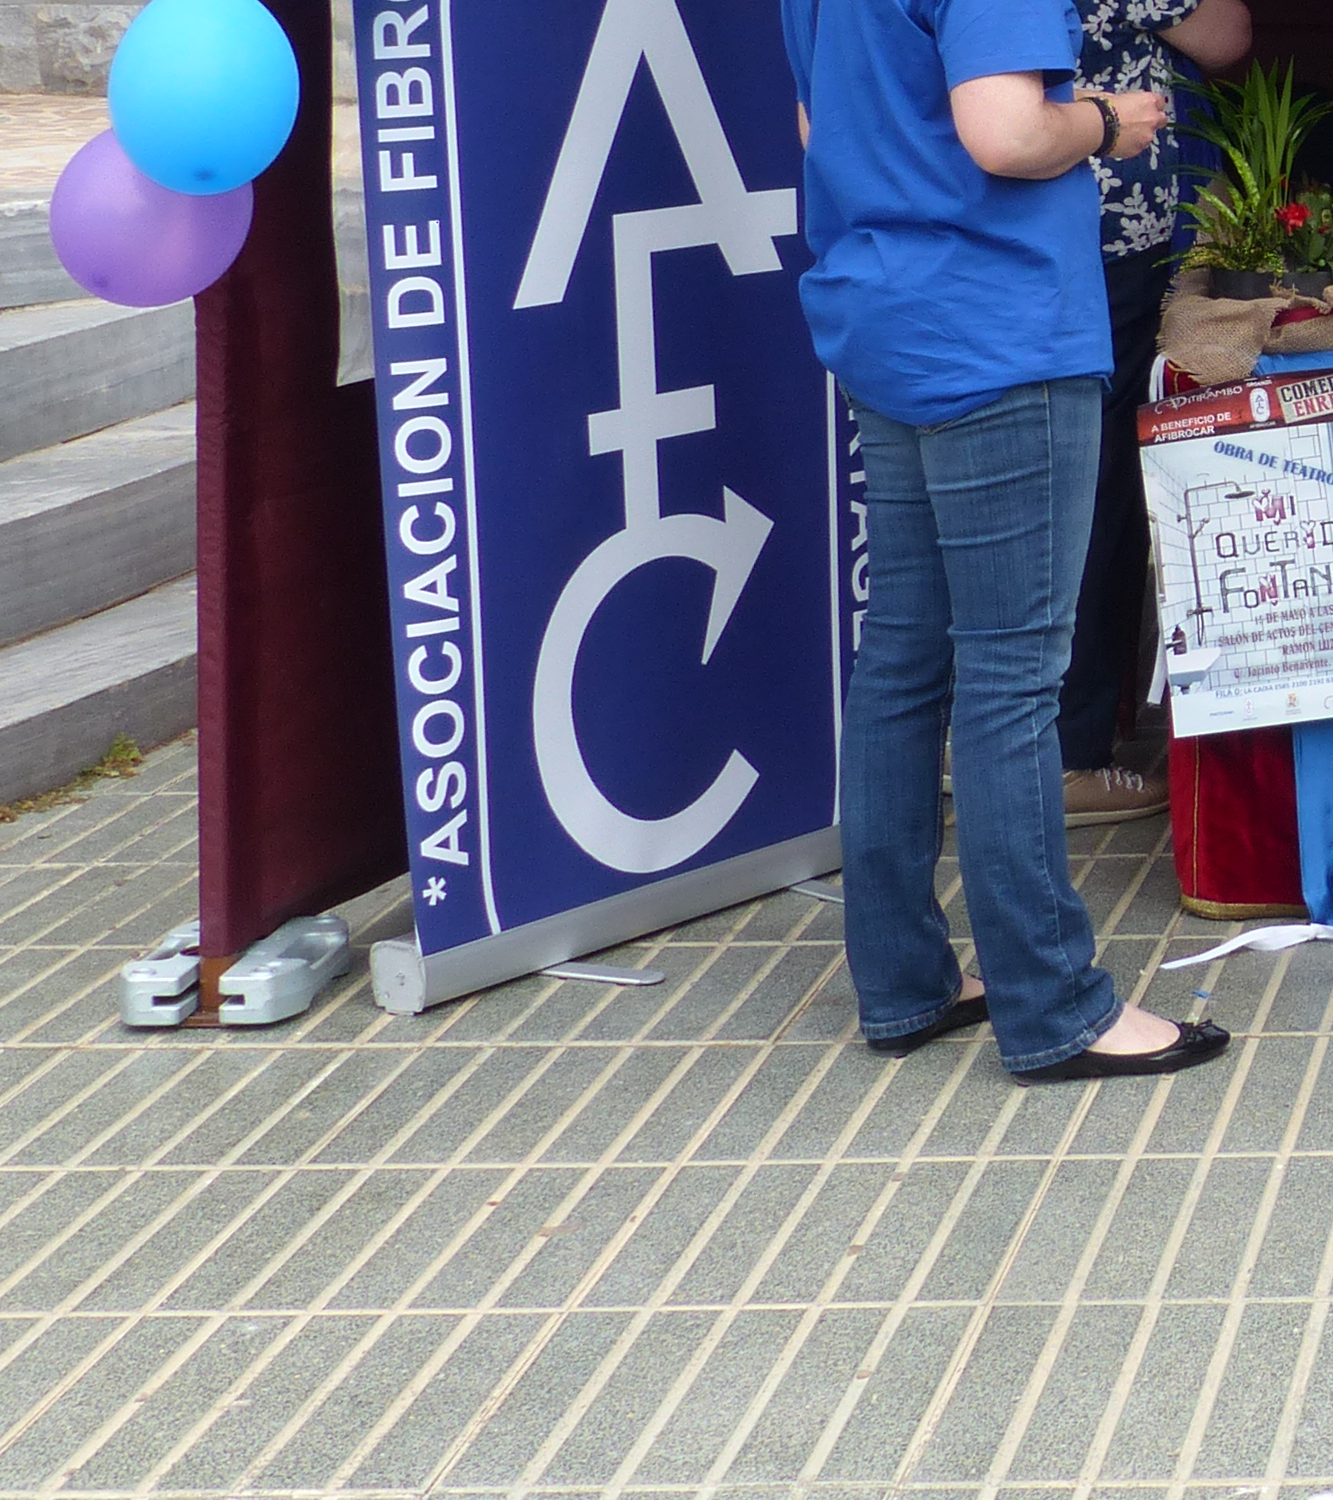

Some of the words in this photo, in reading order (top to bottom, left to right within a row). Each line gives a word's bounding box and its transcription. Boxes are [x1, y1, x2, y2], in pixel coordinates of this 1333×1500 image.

[382, 219, 444, 329] DE
[1151, 424, 1160, 434] A
[1160, 415, 1216, 432] BENEFICIO
[1216, 411, 1233, 422] DE
[1154, 425, 1216, 443] AFIBROCAR
[1213, 440, 1255, 463] OBRA
[1257, 452, 1280, 470] DE
[1252, 492, 1297, 524] MI
[390, 356, 470, 867] ASOCIACION
[1251, 630, 1265, 643] DE
[1266, 626, 1297, 640] ACTOS
